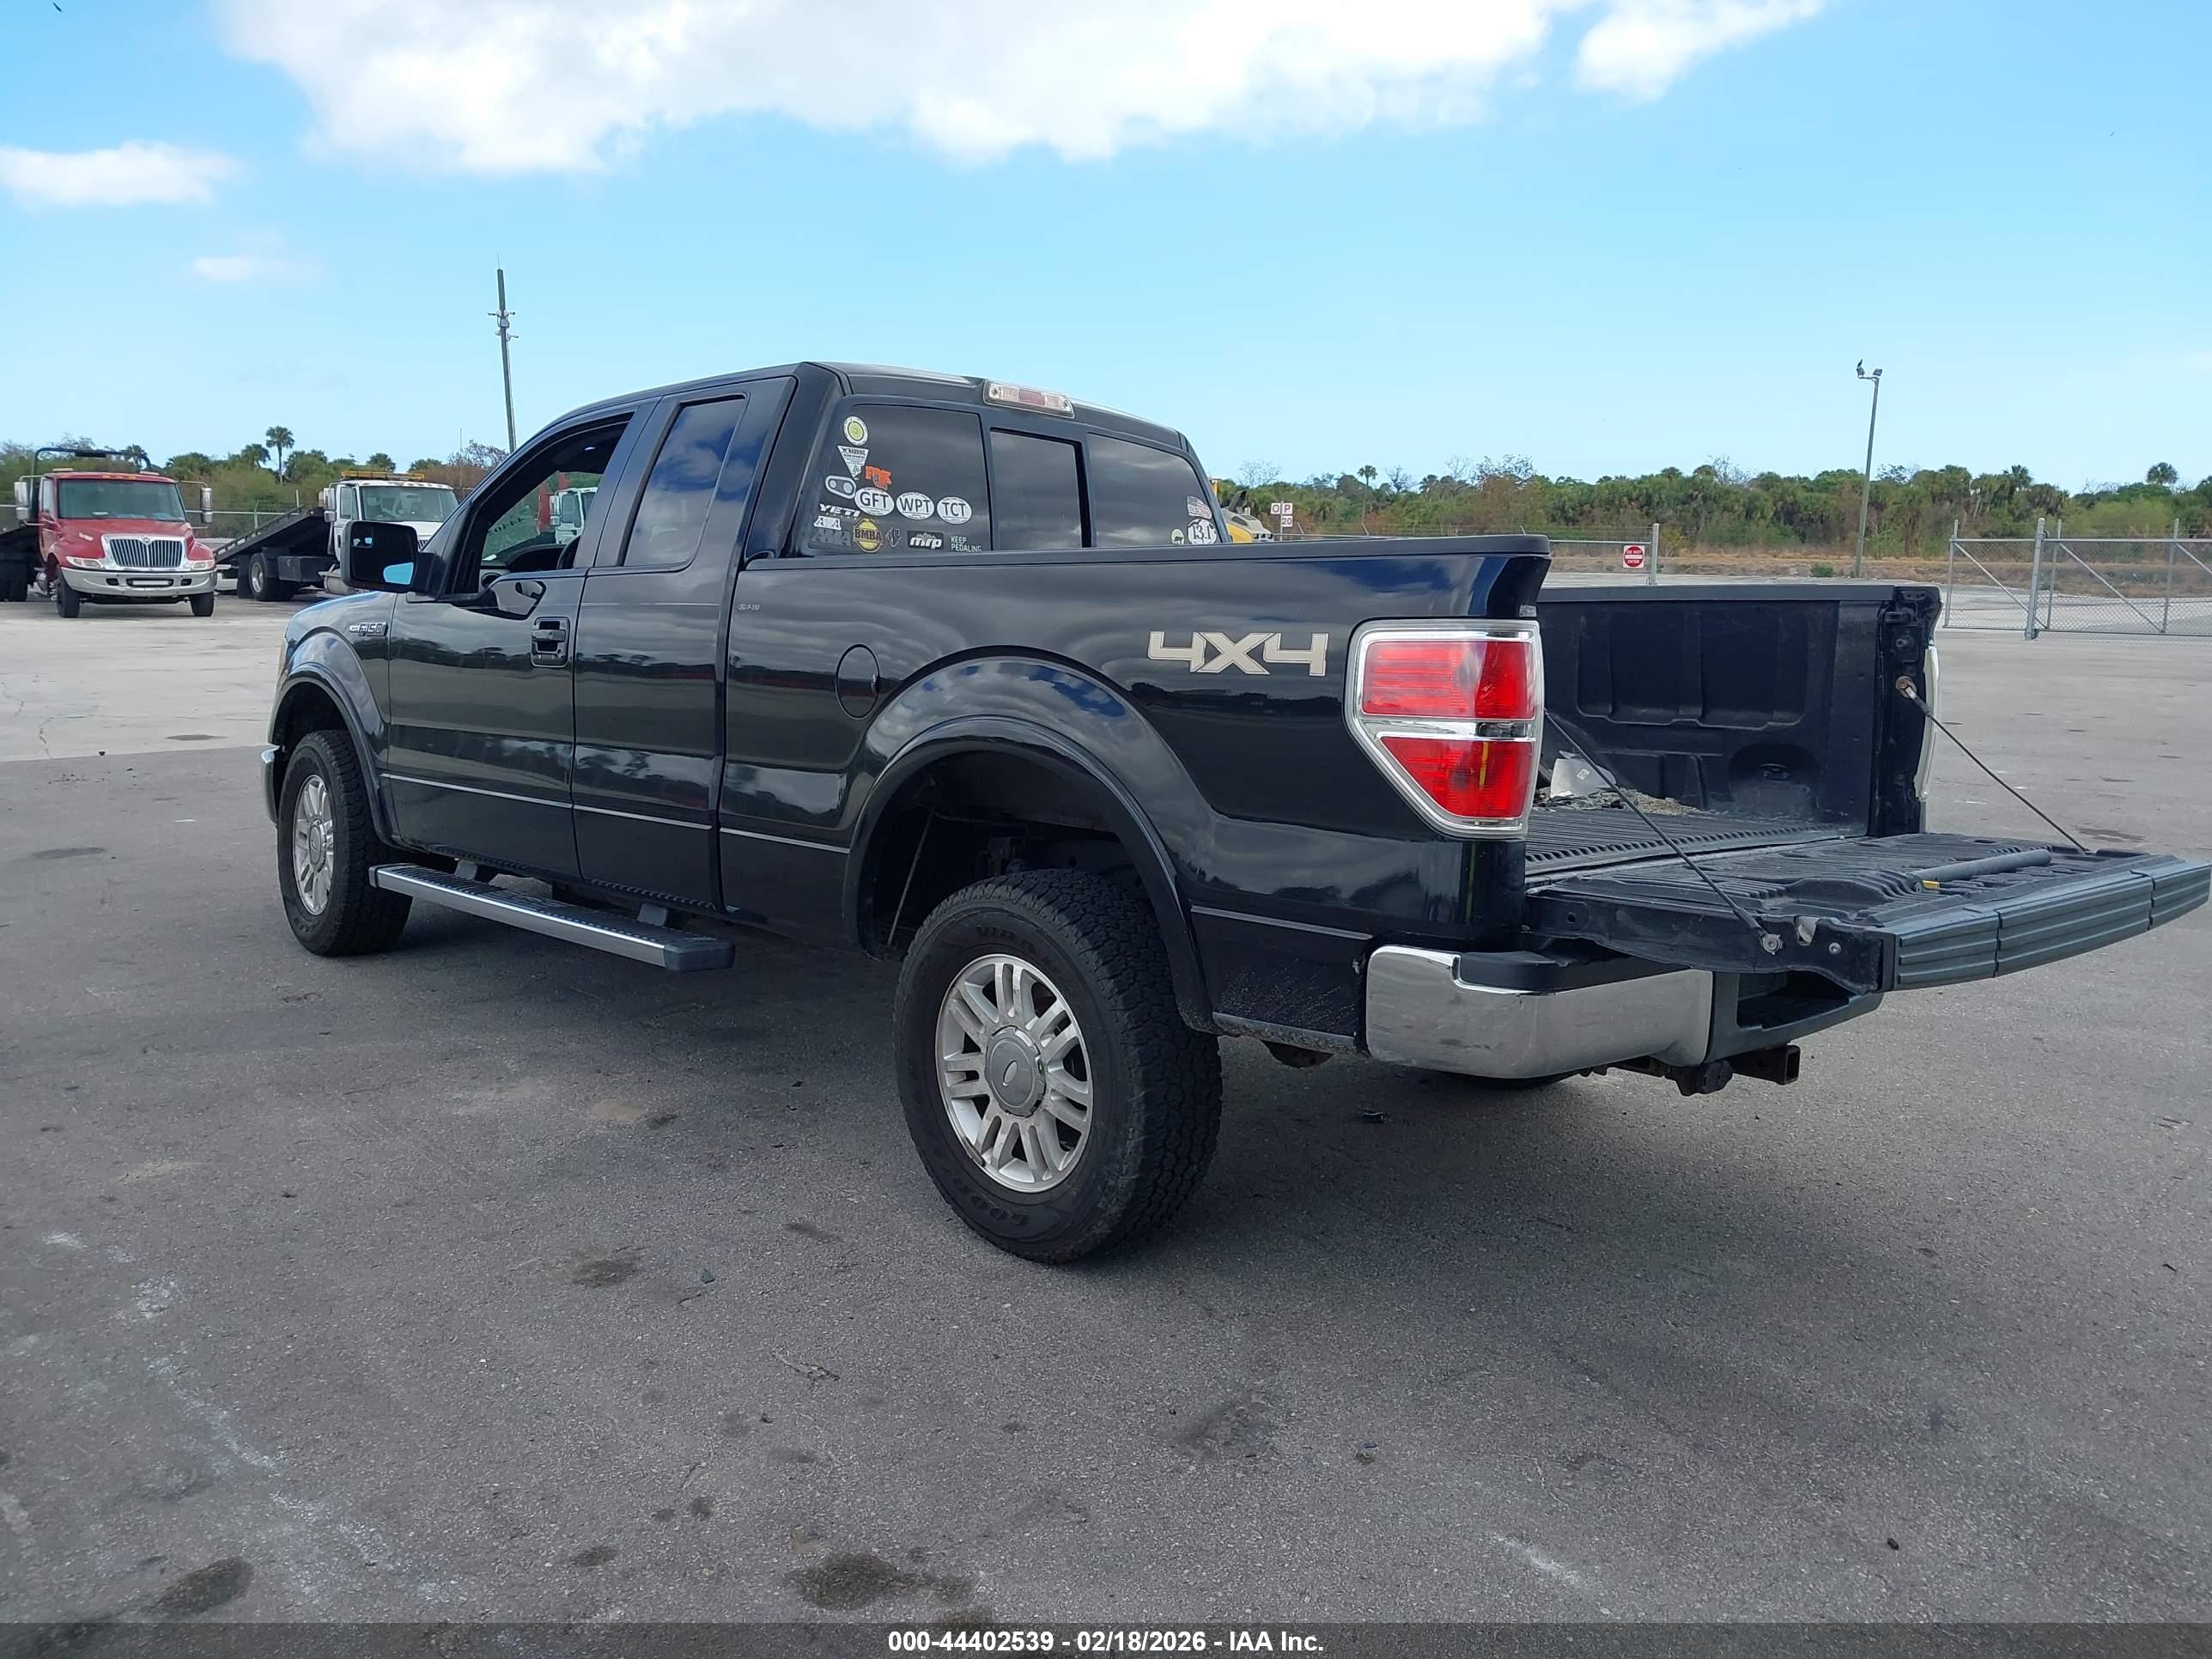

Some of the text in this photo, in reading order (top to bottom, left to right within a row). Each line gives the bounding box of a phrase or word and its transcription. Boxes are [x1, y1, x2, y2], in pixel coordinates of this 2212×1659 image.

[860, 491, 889, 508] GFT
[899, 497, 931, 513] WPT
[819, 503, 860, 517] YETI
[942, 502, 966, 517] TCT
[854, 529, 882, 541] BMBA
[1193, 525, 1212, 540] 13.1
[910, 537, 942, 550] mrp
[951, 536, 967, 544] KEEP
[951, 544, 982, 553] PEDALING
[1148, 631, 1329, 677] 4X4
